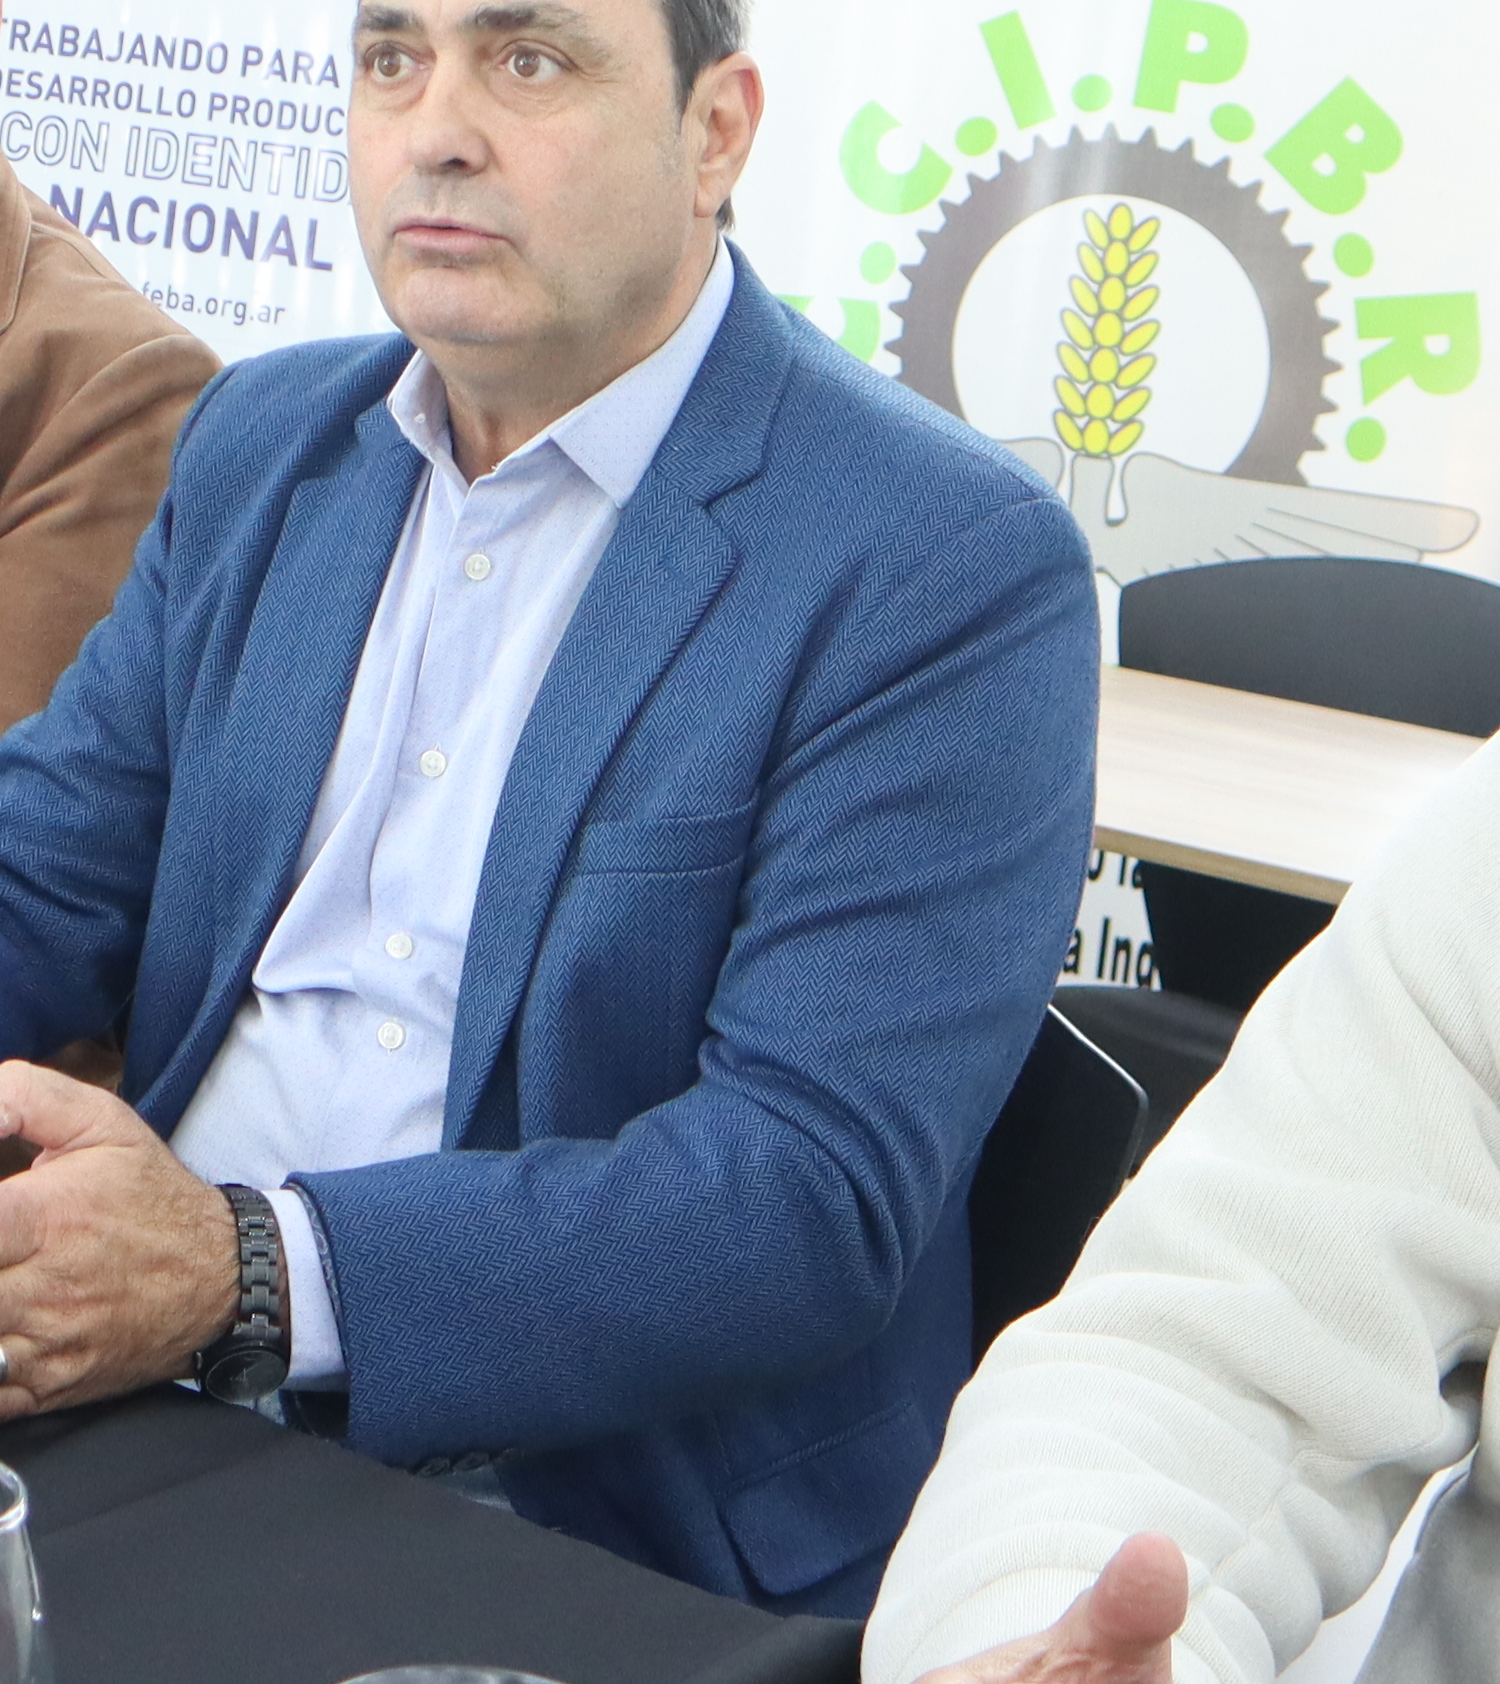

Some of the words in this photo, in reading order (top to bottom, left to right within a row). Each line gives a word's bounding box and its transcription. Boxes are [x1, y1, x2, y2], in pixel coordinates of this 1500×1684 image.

[240, 44, 341, 90] PARA
[0, 110, 110, 173] CON
[124, 124, 353, 206] IDENTID
[50, 182, 333, 273] NACIONAL
